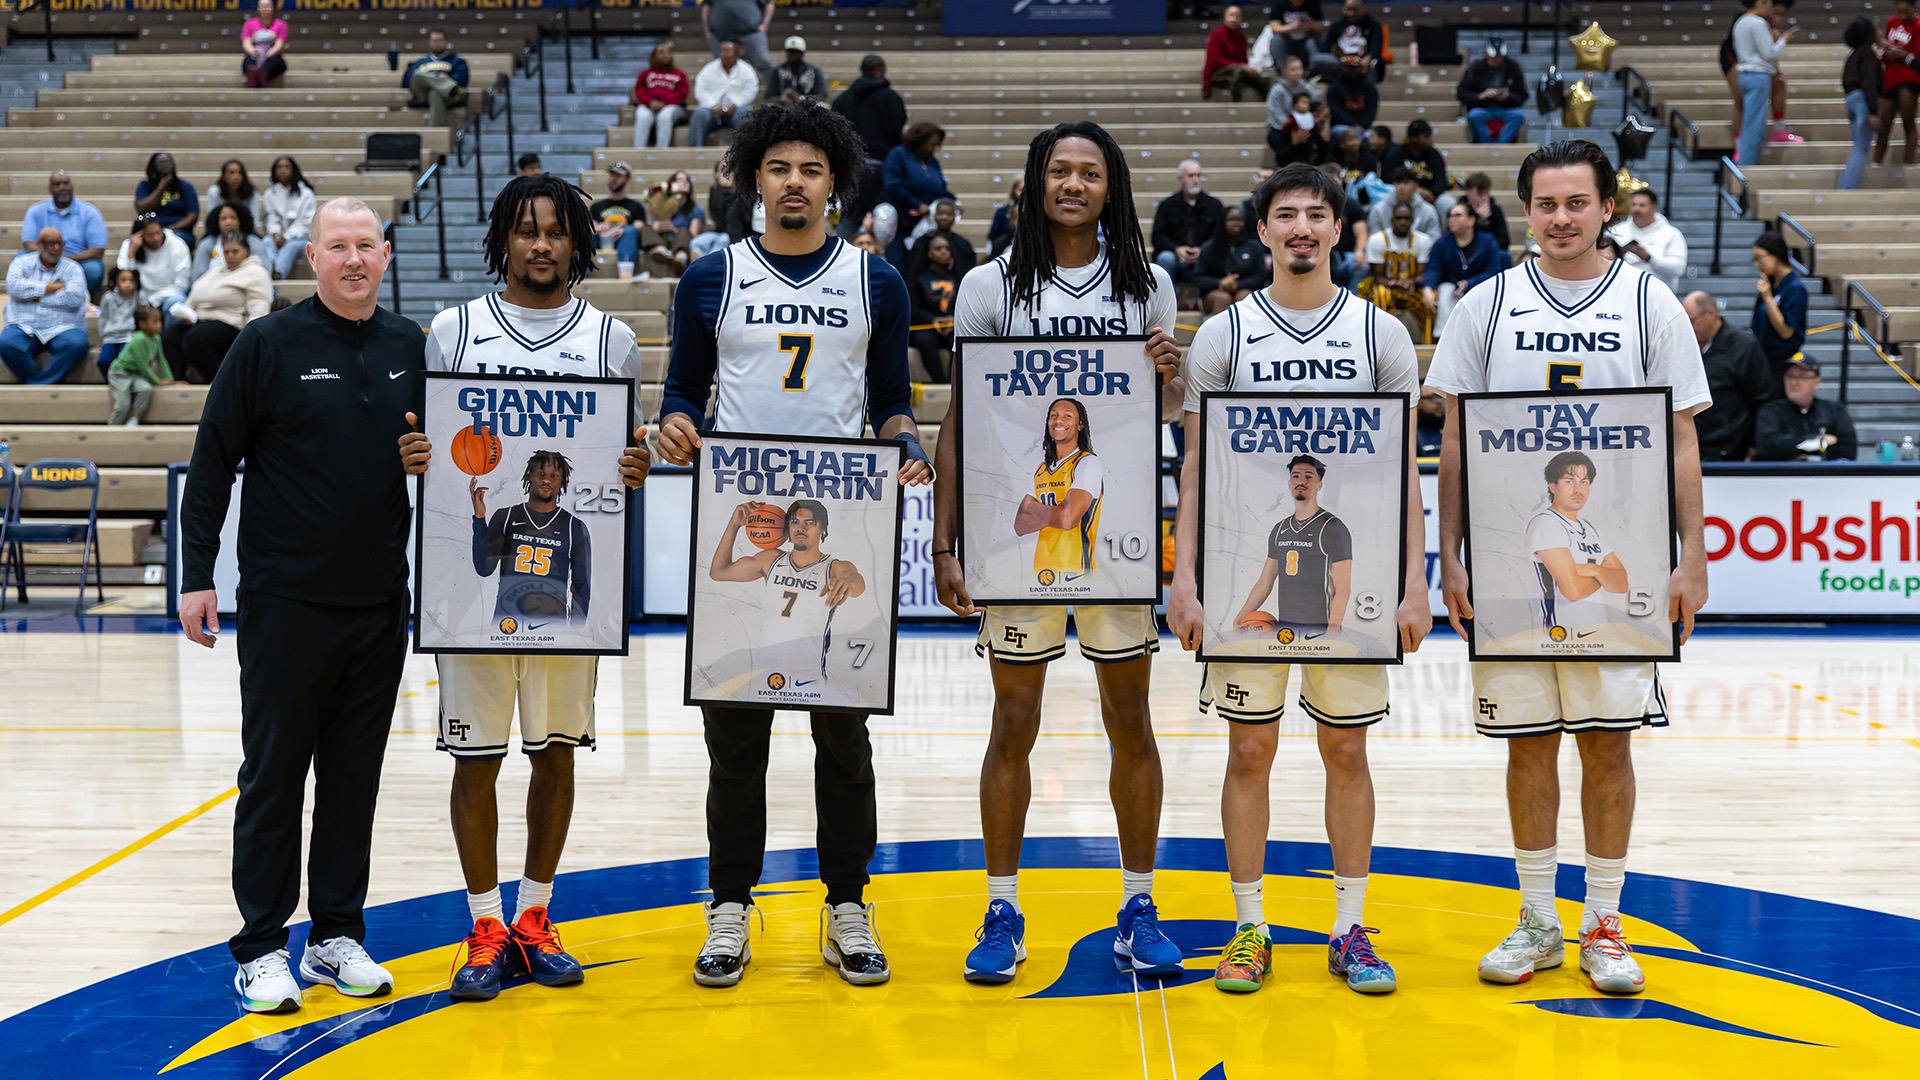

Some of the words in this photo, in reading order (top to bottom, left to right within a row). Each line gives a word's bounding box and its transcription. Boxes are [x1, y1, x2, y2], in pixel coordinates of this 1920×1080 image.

[745, 304, 848, 329] LIONS
[1030, 315, 1127, 336] LIONS
[1515, 331, 1621, 352] LIONS
[778, 333, 814, 392] 7
[1010, 349, 1104, 373] JOSH
[1250, 358, 1357, 382] LIONS
[985, 372, 1131, 396] TAYLOR
[458, 387, 596, 415] GIANNI
[471, 412, 583, 438] HUNT
[1226, 406, 1380, 430] DAMIAN
[1528, 403, 1599, 428] TAY
[1231, 429, 1376, 454] GARCIA
[1479, 425, 1652, 452] MOSHER
[710, 445, 888, 478] MICHAEL
[31, 467, 87, 482] LIONS
[714, 469, 883, 501] FOLARIN
[575, 484, 626, 514] 25
[747, 515, 775, 525] Wilson
[513, 533, 534, 541] EAST
[536, 537, 561, 547] TEXAS
[1105, 532, 1148, 560] 10
[515, 544, 553, 576] 25
[1285, 550, 1299, 576] 8
[773, 574, 818, 591] LIONS
[1820, 568, 1884, 591] food
[1888, 578, 1900, 591] &
[781, 590, 799, 618] 7
[1356, 592, 1382, 620] 8
[1629, 589, 1654, 617] 5
[1004, 625, 1028, 649] ET
[848, 639, 875, 669] 7
[1225, 682, 1250, 707] ET
[1478, 697, 1498, 721] ET
[448, 718, 471, 742] ET
